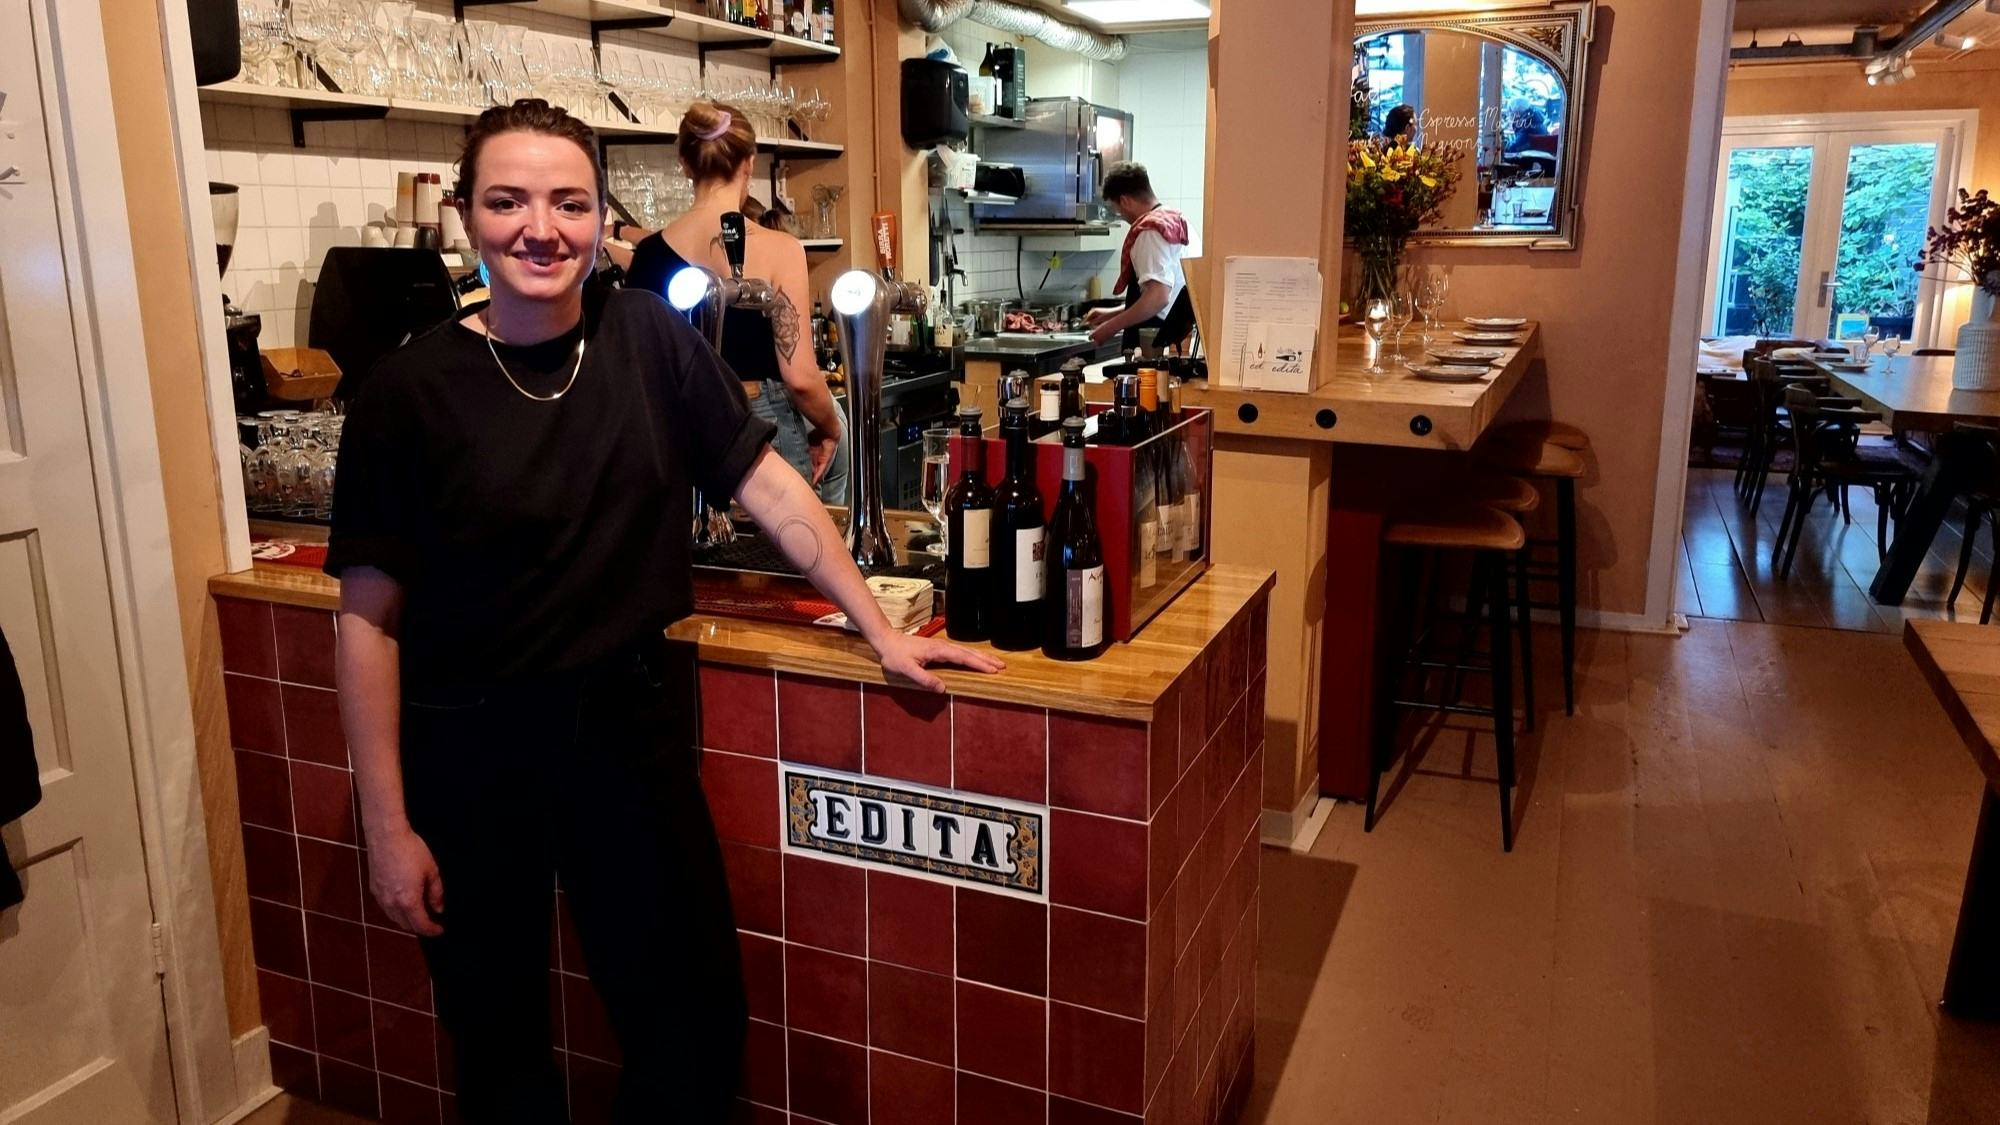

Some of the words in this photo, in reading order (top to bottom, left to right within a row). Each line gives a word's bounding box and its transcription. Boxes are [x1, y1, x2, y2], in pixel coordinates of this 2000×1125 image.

[1418, 108, 1477, 134] Espresso
[1271, 362, 1304, 375] edita
[824, 795, 999, 868] EDITA
